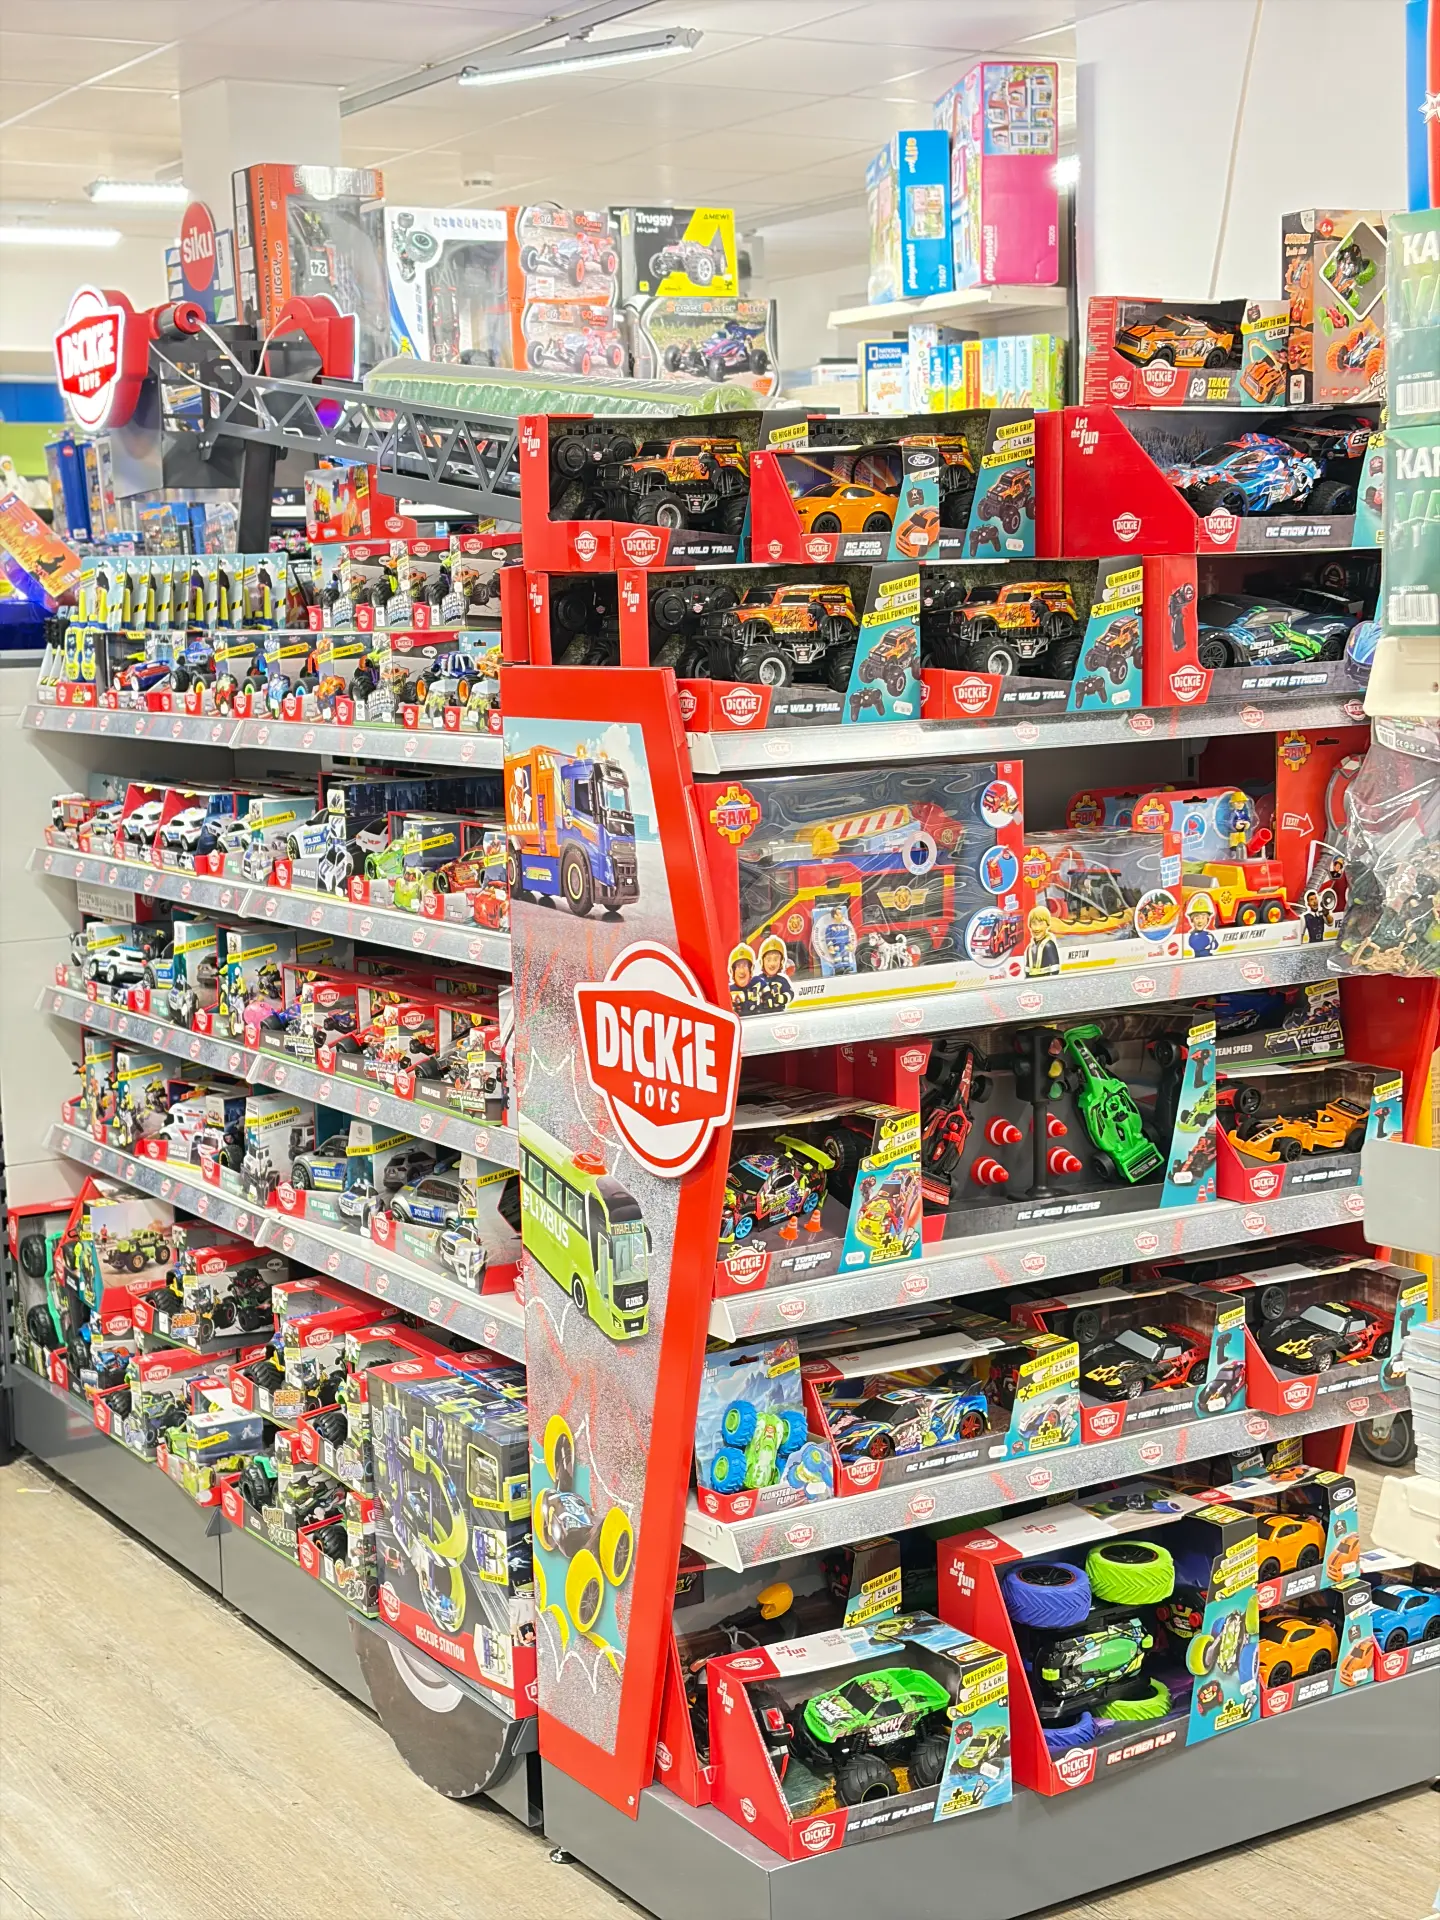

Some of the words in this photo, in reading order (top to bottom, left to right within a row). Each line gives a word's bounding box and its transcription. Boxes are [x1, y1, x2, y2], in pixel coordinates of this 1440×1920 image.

[636, 211, 674, 227] Truggy
[1322, 222, 1332, 232] 6+
[183, 227, 213, 264] siku
[984, 225, 996, 281] playmobil
[311, 262, 326, 276] 24
[79, 374, 101, 393] TOYS
[1207, 376, 1231, 388] TRACK
[1207, 388, 1229, 400] BEAST
[1005, 426, 1019, 437] HIGH
[1020, 422, 1033, 434] GRIP
[1079, 429, 1099, 446] fun
[1352, 433, 1370, 446] 65
[909, 453, 934, 466] Ford
[994, 453, 1006, 464] FULL
[1007, 449, 1033, 461] FUNCTION
[1266, 526, 1280, 538] RC
[1281, 526, 1307, 537] SNOW
[1308, 524, 1331, 536] LYNX
[672, 547, 686, 555] RC
[687, 546, 706, 555] WILD
[706, 545, 735, 554] TRAIL
[844, 548, 883, 556] MUSTANG
[845, 542, 858, 550] RC
[859, 541, 881, 549] FORD
[888, 583, 902, 593] HIGH
[903, 578, 918, 589] GRIP
[876, 611, 889, 621] FULL
[890, 605, 918, 618] FUNCTION
[1241, 678, 1257, 689] RC
[1258, 676, 1287, 688] DEPTH
[1288, 673, 1328, 686] STRIDER
[1003, 692, 1017, 701] RC
[1018, 691, 1039, 700] WILD
[1041, 690, 1067, 699] TRAIL
[773, 704, 789, 715] RC
[789, 704, 812, 714] WILD
[813, 703, 841, 713] TRAIL
[717, 811, 752, 826] SAM
[1142, 814, 1166, 826] SAM
[1023, 864, 1047, 876] SAM
[1068, 950, 1090, 960] NEPTUN
[799, 984, 825, 997] JUPITER
[1266, 1020, 1340, 1045] FORMULA
[1216, 1047, 1233, 1057] TEAM
[1233, 1044, 1253, 1056] SPEED
[633, 1081, 681, 1114] TOYS
[900, 1117, 917, 1130] DRIFT
[375, 1141, 388, 1151] LIGHT
[392, 1134, 407, 1145] SOUND
[878, 1153, 889, 1164] USB
[890, 1142, 917, 1160] CHARGING
[313, 1168, 331, 1178] POLIZEI
[1291, 1175, 1303, 1184] RC
[1304, 1171, 1327, 1182] SPEED
[1328, 1168, 1352, 1178] RACER
[413, 1207, 431, 1218] POLIZEI
[1017, 1210, 1032, 1221] RC
[1032, 1206, 1063, 1219] SPEED
[1064, 1201, 1101, 1214] RACERS
[781, 1259, 793, 1269] RC
[793, 1252, 832, 1267] TORNADO
[793, 1260, 818, 1272] DRIFT
[1034, 1354, 1051, 1369] LIGHT
[1056, 1346, 1075, 1360] SOUND
[1054, 1364, 1064, 1373] 2.4
[1064, 1359, 1076, 1369] GHz
[1035, 1381, 1048, 1393] FULL
[1049, 1371, 1076, 1389] FUNCTION
[1317, 1387, 1328, 1396] RC
[1348, 1374, 1379, 1388] PHANTOM
[1126, 1412, 1138, 1421] RC
[1160, 1401, 1193, 1416] PHANTOM
[906, 1463, 920, 1473] RC
[920, 1458, 945, 1470] LASER
[945, 1450, 979, 1466] SAMURAI
[761, 1488, 791, 1501] MONSTER
[777, 1494, 798, 1506] FLIPPY
[1335, 1488, 1352, 1499] Ford
[954, 1558, 965, 1572] Let
[869, 1578, 883, 1590] HIGH
[883, 1572, 898, 1585] GRIP
[957, 1571, 975, 1590] fun
[1287, 1579, 1299, 1588] RC
[1299, 1574, 1316, 1585] FORD
[1286, 1581, 1316, 1596] MUSTANG
[1350, 1594, 1368, 1605] Ford
[857, 1609, 870, 1620] FULL
[871, 1595, 899, 1616] FUNCTION
[415, 1624, 437, 1650] RESCUE
[437, 1634, 465, 1662] STATION
[964, 1662, 1005, 1684] WATERPROOF
[1298, 1686, 1329, 1702] MUSTANG
[1299, 1683, 1311, 1694] RC
[1311, 1679, 1329, 1691] FORD
[963, 1699, 975, 1712] USB
[976, 1687, 1005, 1706] CHARGING
[1106, 1751, 1122, 1765] RC
[1122, 1739, 1155, 1760] CYBER
[1155, 1730, 1177, 1749] FLIP
[847, 1820, 861, 1832] RC
[861, 1811, 890, 1829] AMPHY
[891, 1801, 935, 1822] SPLASHER
